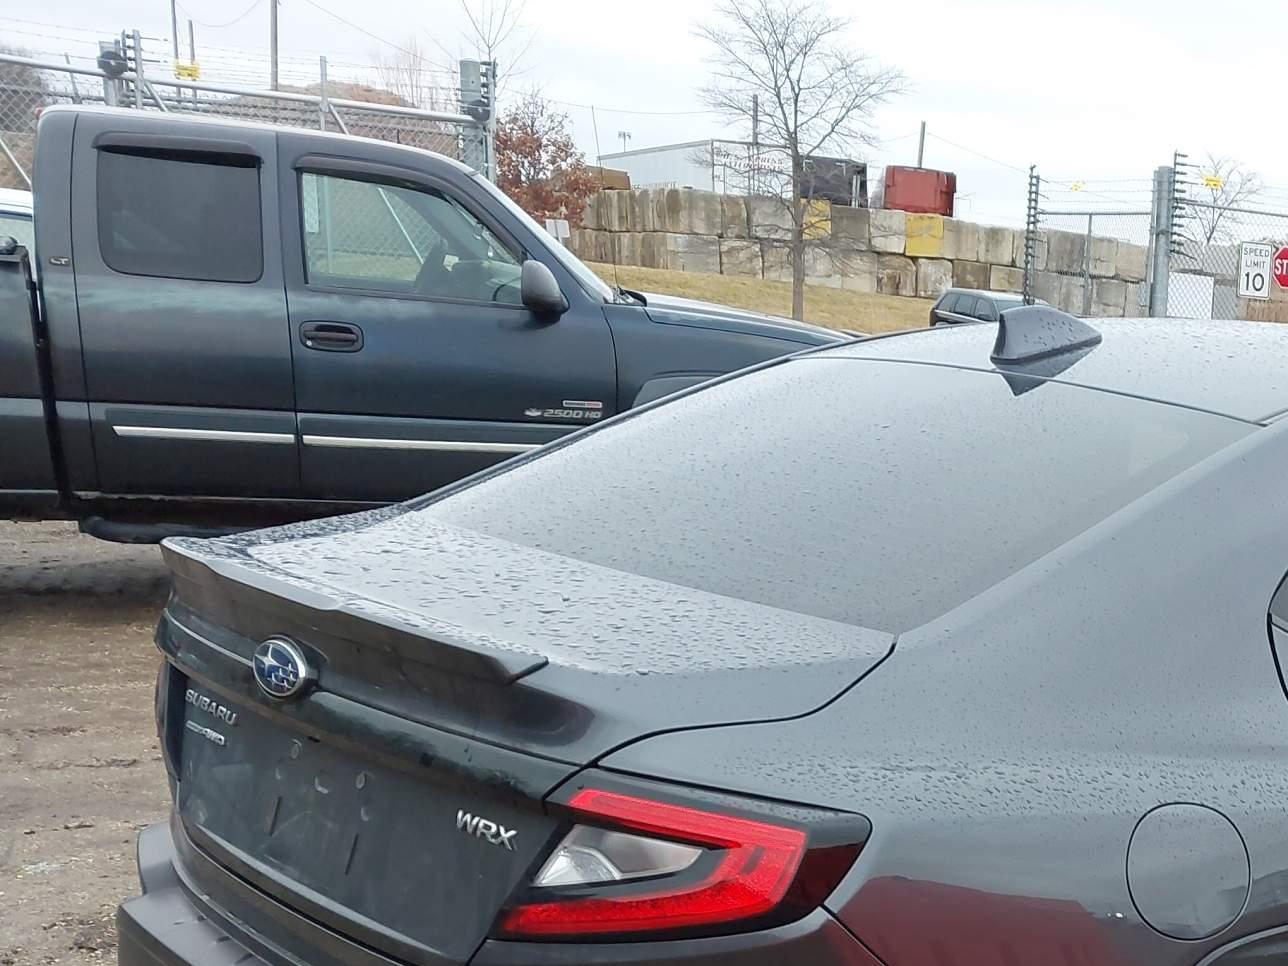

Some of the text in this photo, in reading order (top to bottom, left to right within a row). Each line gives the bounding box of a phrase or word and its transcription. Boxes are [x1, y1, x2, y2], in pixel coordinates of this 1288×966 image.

[1243, 247, 1270, 257] SPEED
[1245, 259, 1266, 268] LIMIT
[1245, 271, 1264, 292] 10
[543, 409, 602, 419] 2500 HD
[185, 688, 237, 726] SUBARU
[456, 809, 518, 851] WRX
